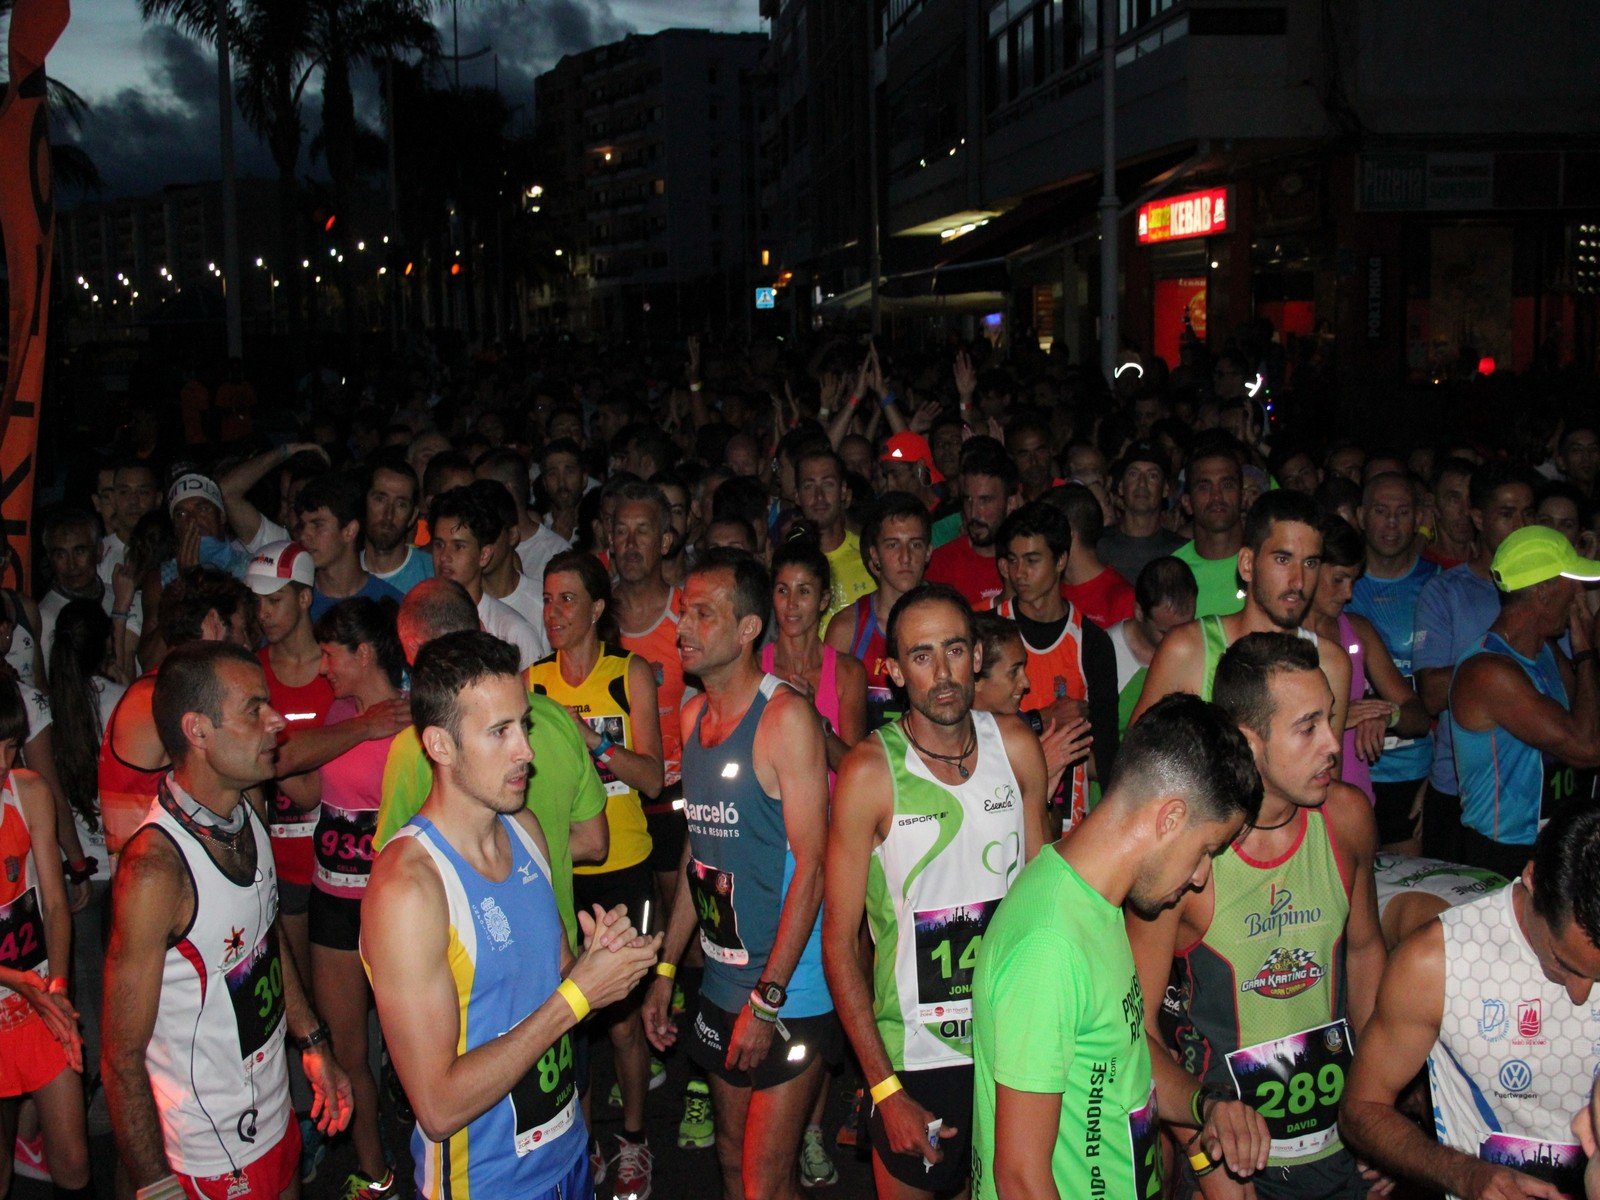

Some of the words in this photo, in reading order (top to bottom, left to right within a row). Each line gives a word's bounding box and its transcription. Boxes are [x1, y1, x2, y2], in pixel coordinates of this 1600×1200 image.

[1170, 196, 1212, 236] KEBAB
[682, 798, 739, 824] Barceló
[898, 813, 938, 827] GSPORT
[321, 829, 378, 860] 930
[708, 828, 740, 838] RESORTS
[1244, 904, 1321, 937] Barpimo
[1255, 1063, 1345, 1119] 289
[1085, 1061, 1107, 1158] RENDIRSE
[1286, 1118, 1318, 1133] DAVID
